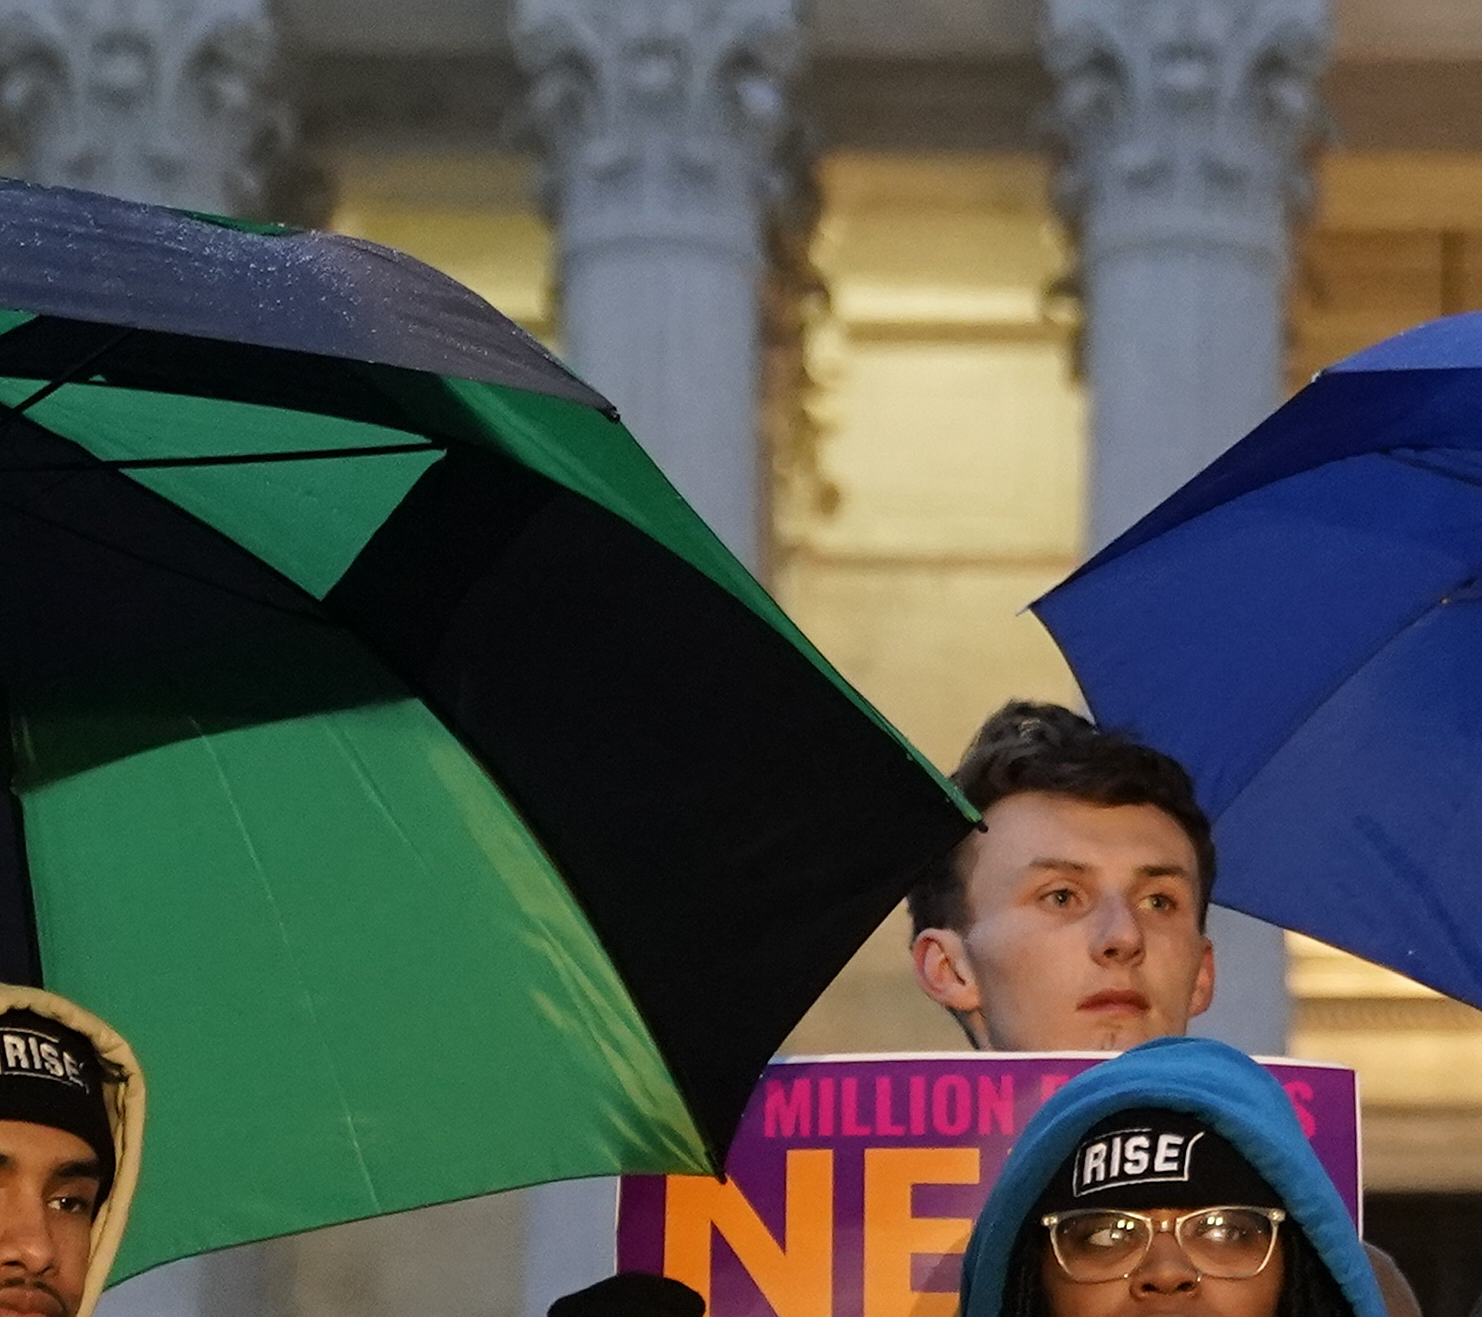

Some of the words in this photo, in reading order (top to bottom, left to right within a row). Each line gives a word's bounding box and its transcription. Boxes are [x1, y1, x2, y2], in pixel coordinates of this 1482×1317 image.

[2, 1034, 81, 1079] RISE
[764, 1075, 1014, 1138] MILLION
[1082, 1133, 1185, 1186] RISE
